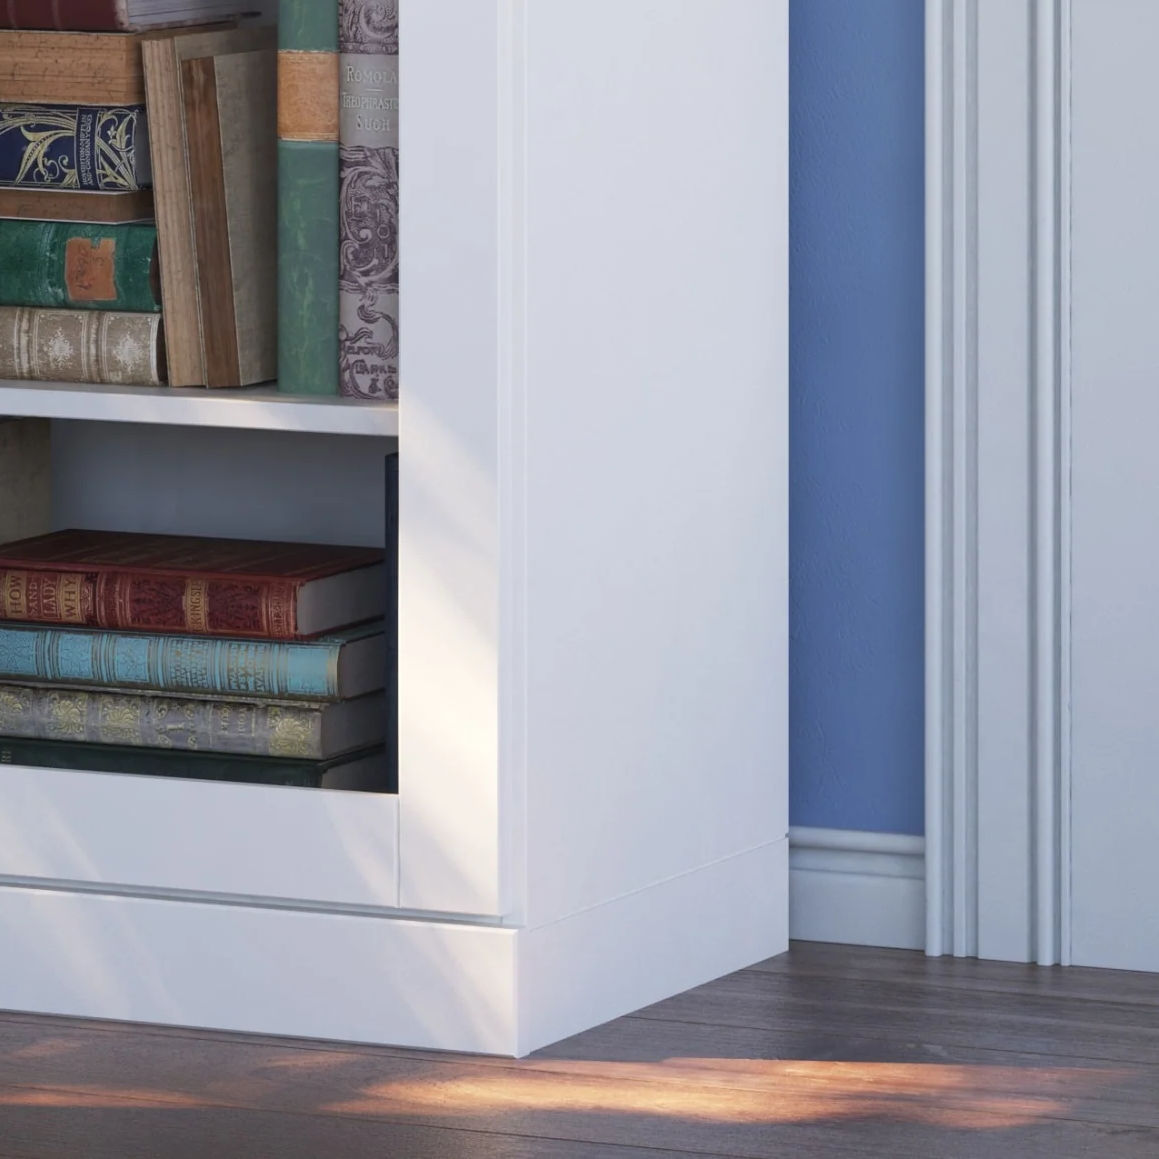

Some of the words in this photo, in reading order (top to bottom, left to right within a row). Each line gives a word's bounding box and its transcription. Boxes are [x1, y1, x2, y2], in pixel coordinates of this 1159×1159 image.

[346, 66, 398, 83] ROMOLA
[356, 114, 391, 131] SUCH
[9, 575, 23, 614] HOW
[43, 578, 56, 614] LADY
[64, 577, 77, 618] WHY
